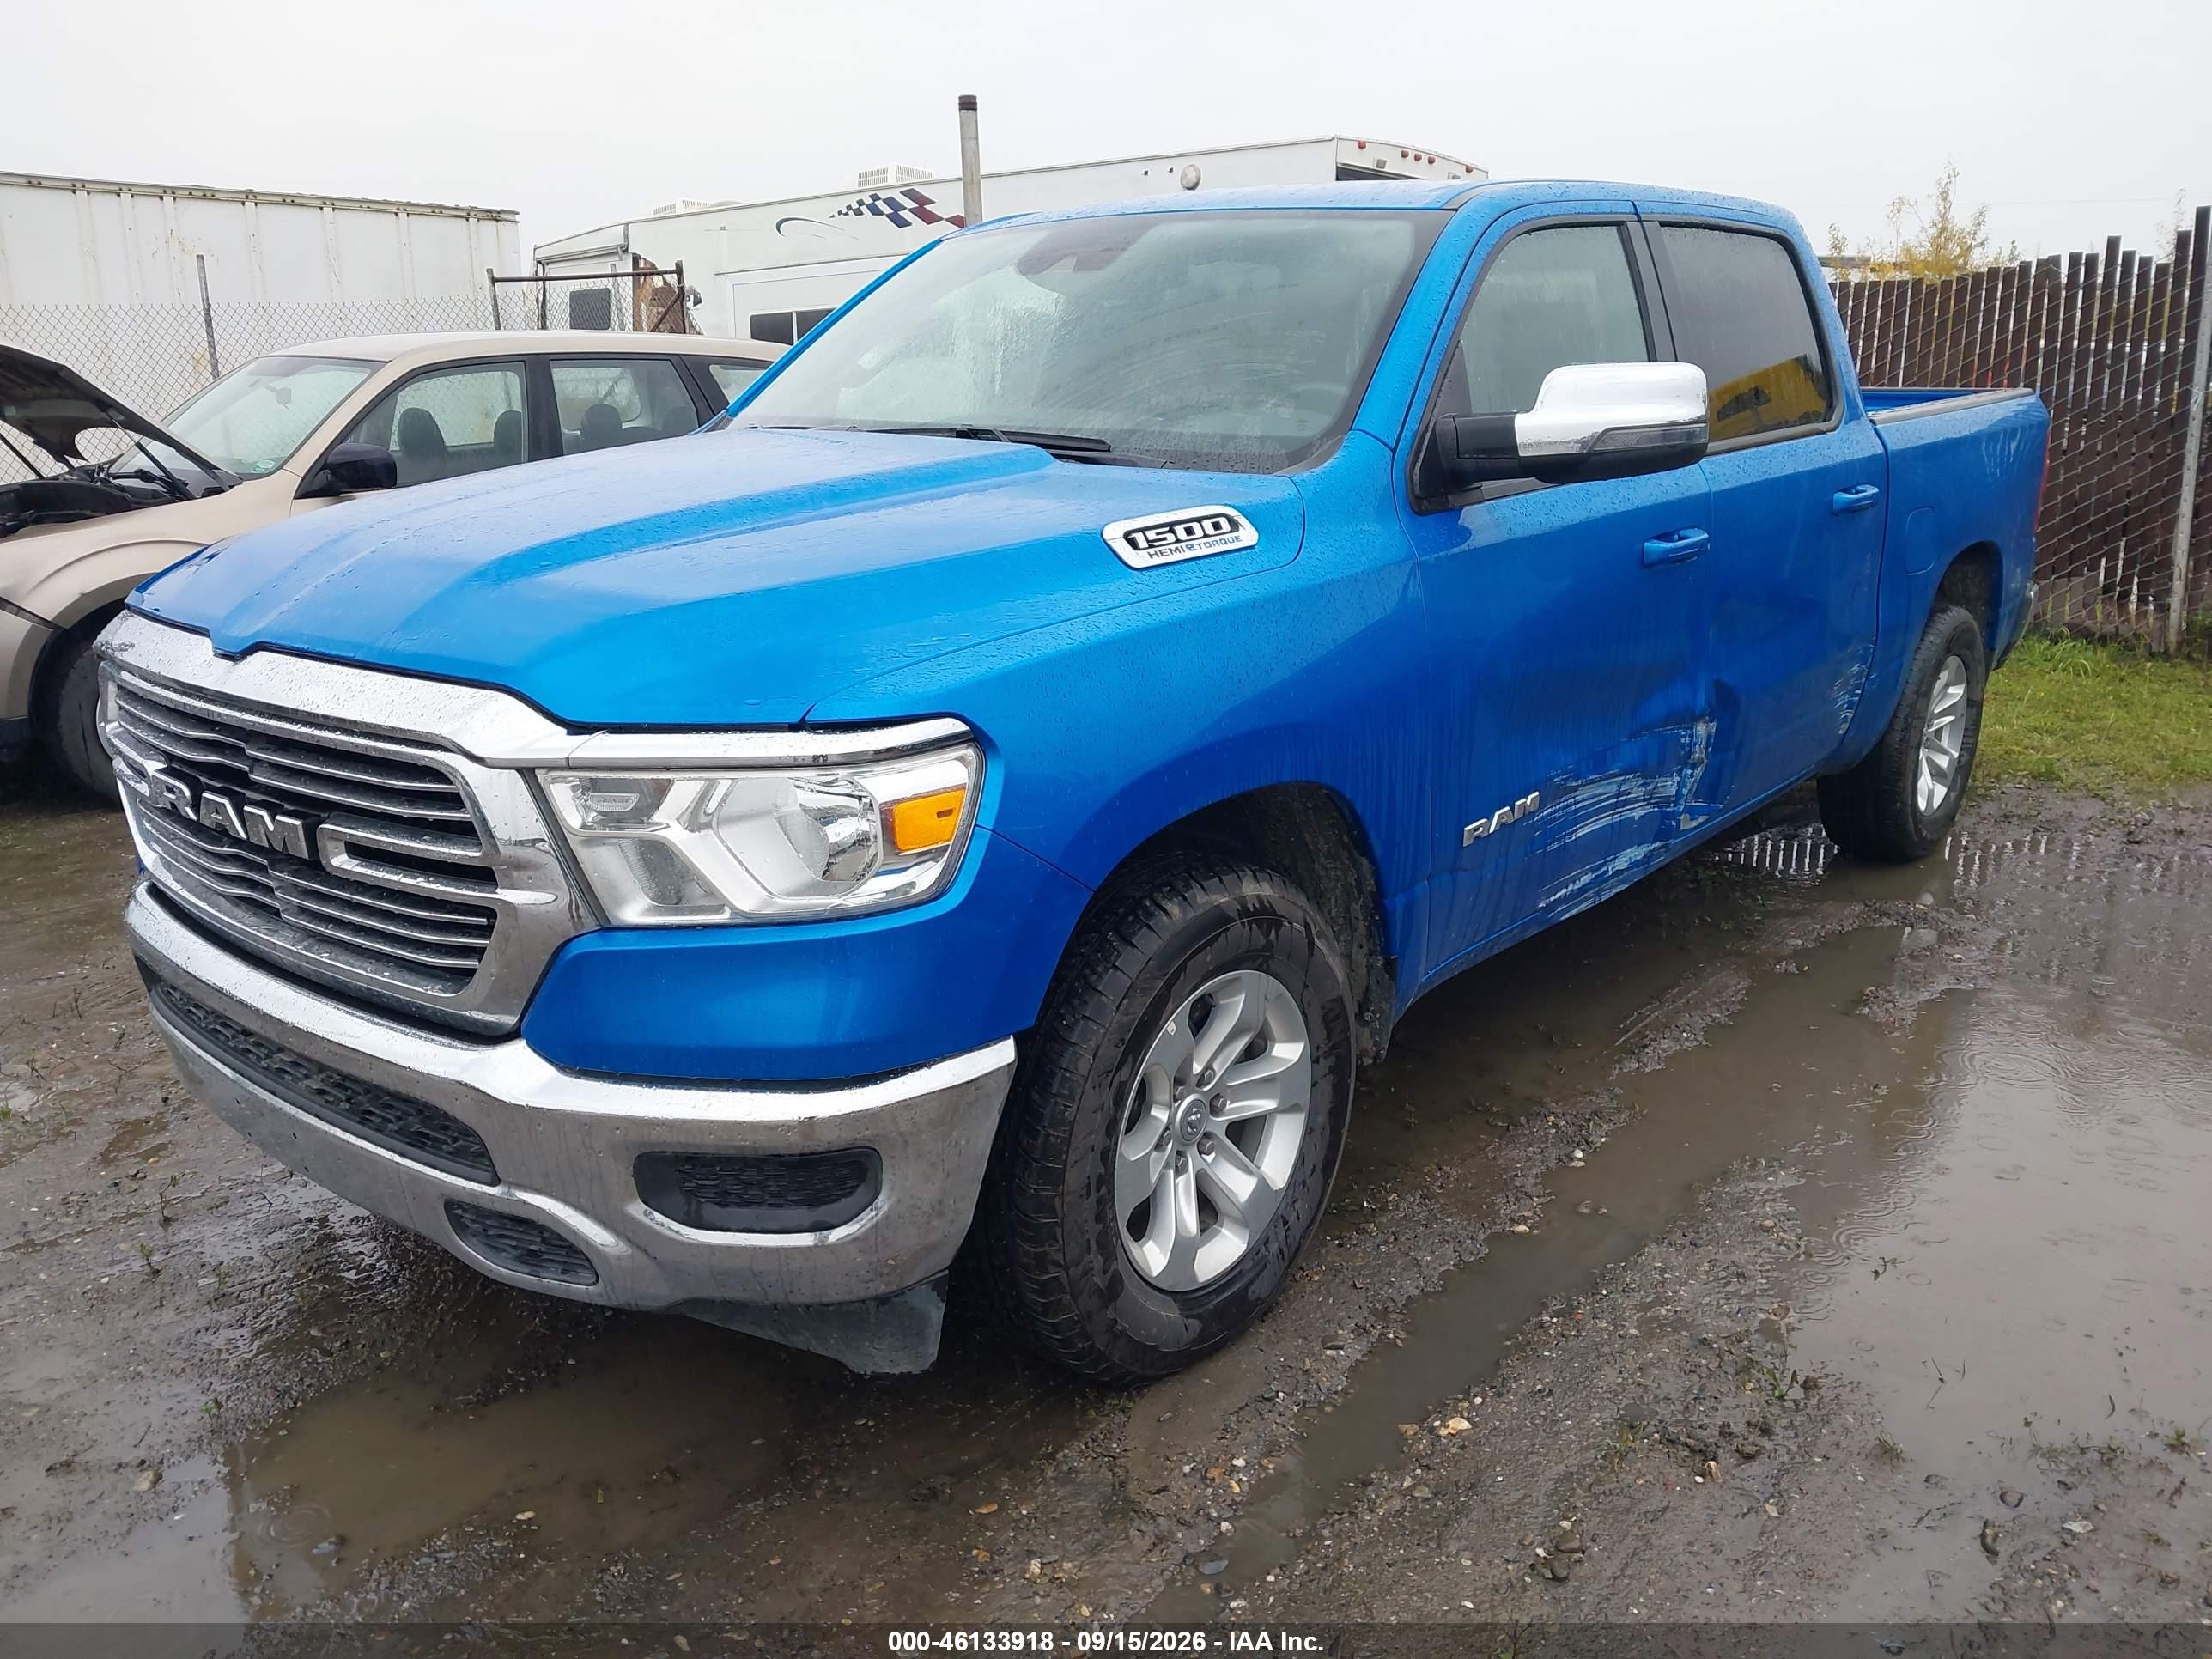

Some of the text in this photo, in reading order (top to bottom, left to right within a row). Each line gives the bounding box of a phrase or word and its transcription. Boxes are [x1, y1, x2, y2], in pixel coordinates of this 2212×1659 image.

[1127, 516, 1231, 550] 1500
[149, 770, 310, 860] RAM
[1462, 791, 1540, 848] RAM
